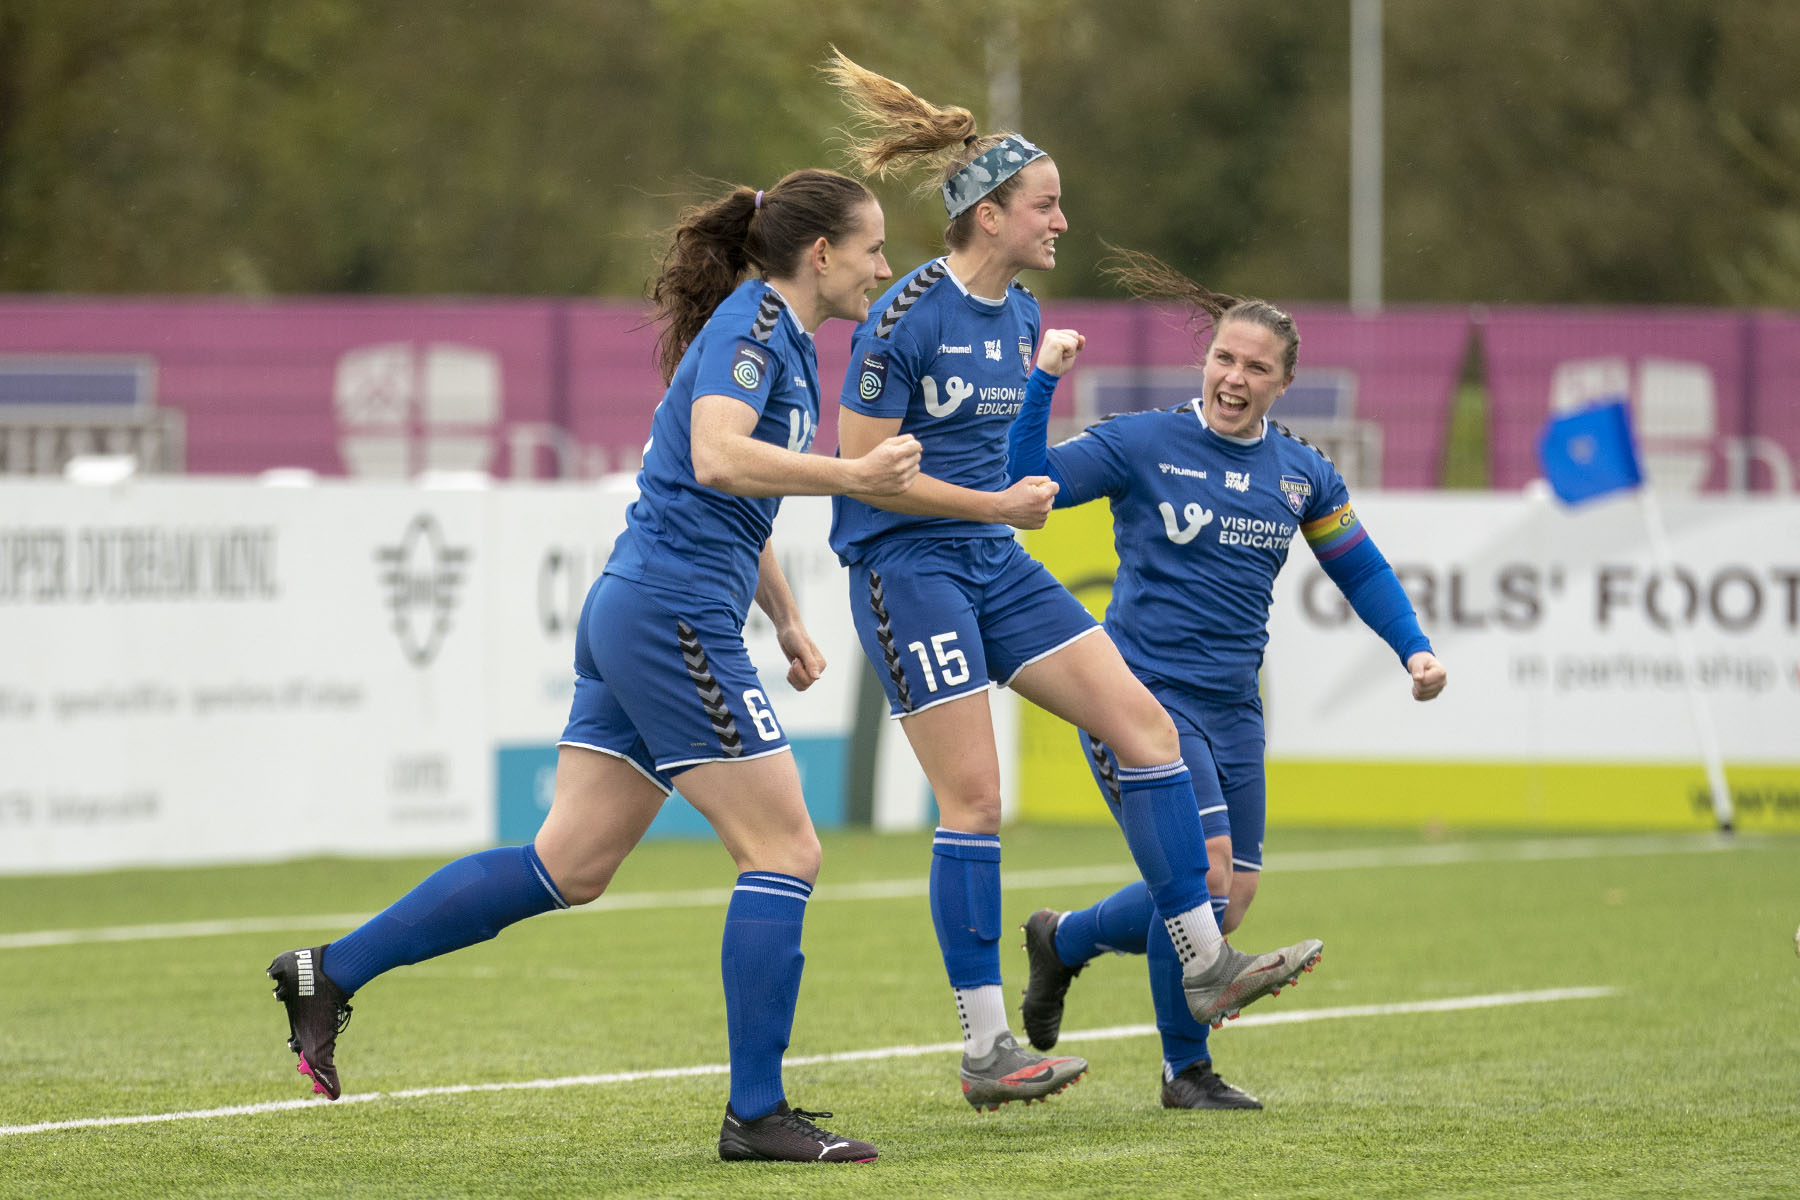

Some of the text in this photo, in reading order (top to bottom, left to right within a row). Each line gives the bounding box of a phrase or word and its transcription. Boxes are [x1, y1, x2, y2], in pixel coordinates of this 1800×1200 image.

[942, 344, 972, 354] hummel
[979, 387, 1016, 401] VISION
[1171, 464, 1207, 479] hummel
[1282, 481, 1309, 495] DURHAM
[1220, 516, 1293, 537] VISION for
[1300, 562, 1800, 634] GRLS' FOOT
[908, 631, 970, 693] 15
[742, 688, 781, 742] 6
[295, 949, 315, 996] PUMA
